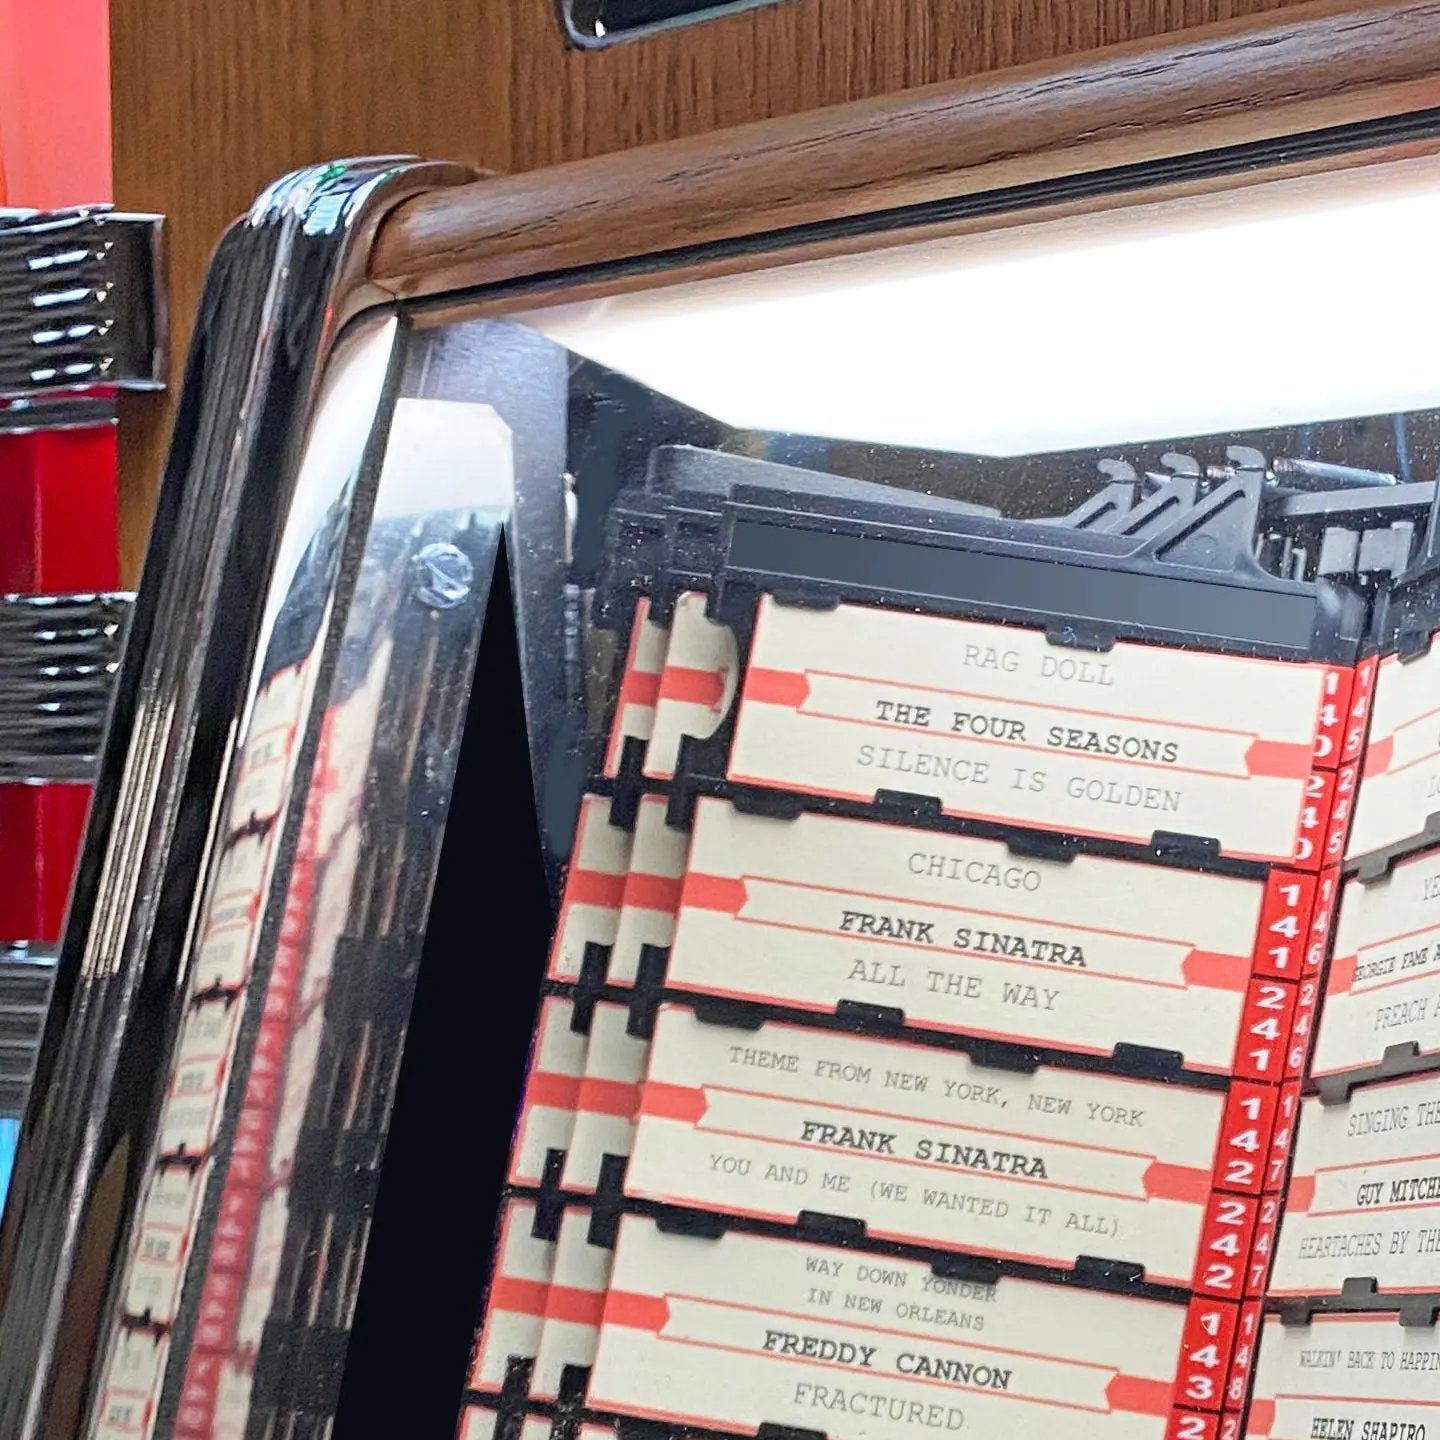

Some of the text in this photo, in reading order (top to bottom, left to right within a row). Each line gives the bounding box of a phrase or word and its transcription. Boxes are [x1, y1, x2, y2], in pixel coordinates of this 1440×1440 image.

[962, 643, 1114, 686] RAG DOLL
[876, 699, 1179, 763] THE FOUR SEASONS
[856, 744, 1183, 812] SILENCE IS GOLDEN
[908, 851, 1042, 892] CHICAGO
[838, 910, 1087, 968] FRANK SINATRA
[847, 959, 1061, 1011] ALL THE WAY
[1374, 997, 1429, 1031] PREACH
[729, 1045, 1144, 1128] THEME FROM NEW YORK, NEW YORK
[1347, 1105, 1409, 1137] SINGING
[800, 1120, 1048, 1180] FRANK SINATRA
[709, 1153, 1119, 1239] YOU AND ME (WE WANTED IT ALL)
[1356, 1182, 1385, 1206] GUY
[1388, 1230, 1411, 1255] BY
[805, 1256, 999, 1303] WAY DOWN YONDER
[807, 1287, 985, 1332] IN NEW ORLEANS
[762, 1329, 1013, 1390] FREDDY CANNON
[793, 1381, 965, 1431] FRACTURED
